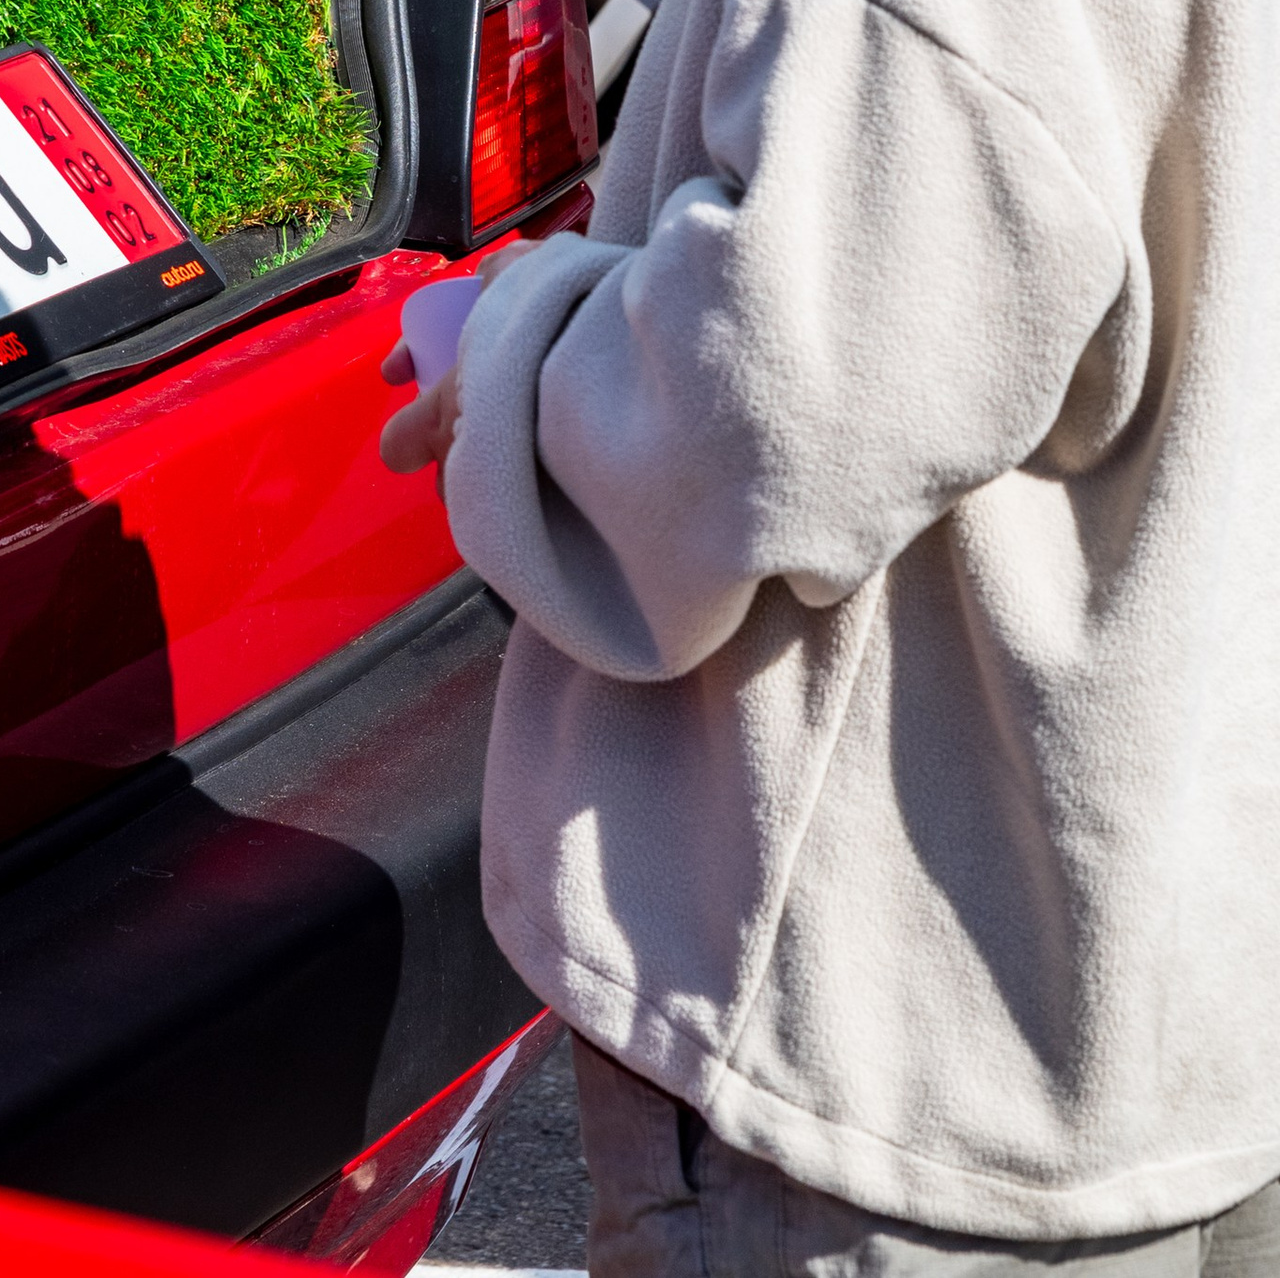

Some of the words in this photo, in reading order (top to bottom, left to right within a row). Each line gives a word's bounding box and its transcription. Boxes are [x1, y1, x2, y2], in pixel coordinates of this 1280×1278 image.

[21, 98, 73, 144] 21
[64, 150, 113, 194] 08
[106, 203, 157, 247] 02
